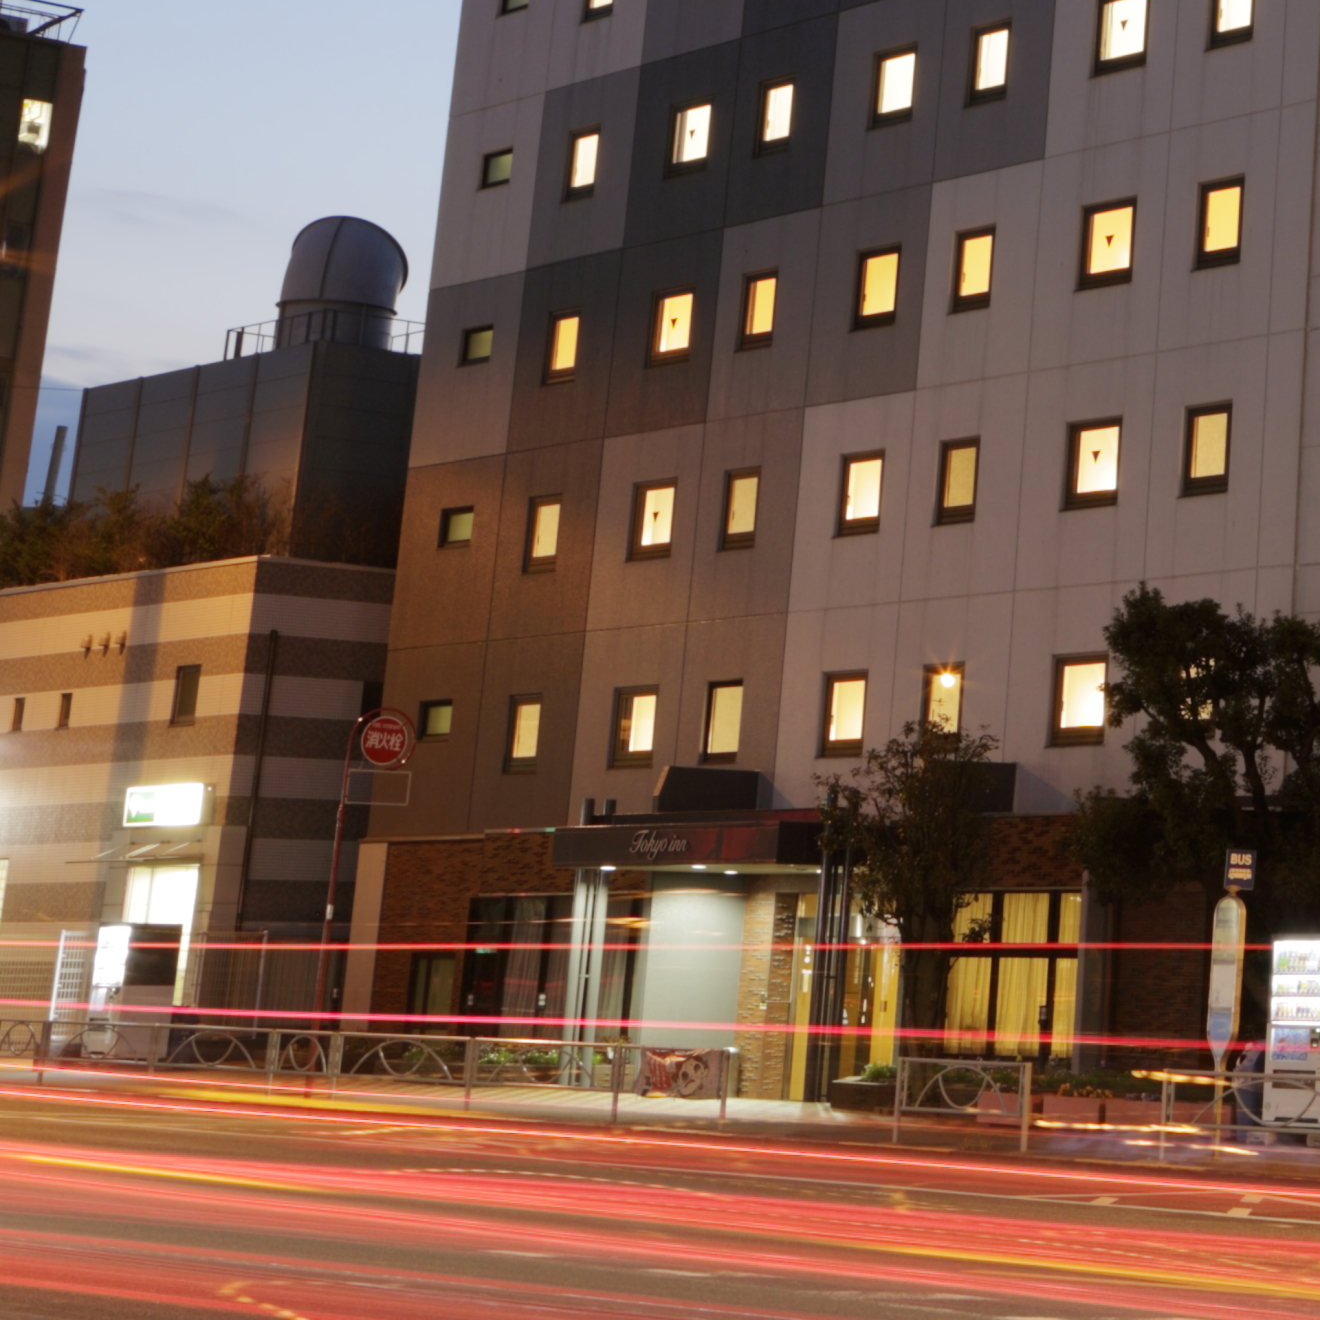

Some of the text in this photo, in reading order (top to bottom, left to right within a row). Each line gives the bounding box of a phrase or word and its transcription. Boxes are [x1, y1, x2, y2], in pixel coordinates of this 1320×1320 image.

[365, 730, 404, 751] 消火栓
[629, 830, 688, 860] Tokyo inn
[1230, 853, 1252, 865] BUS
